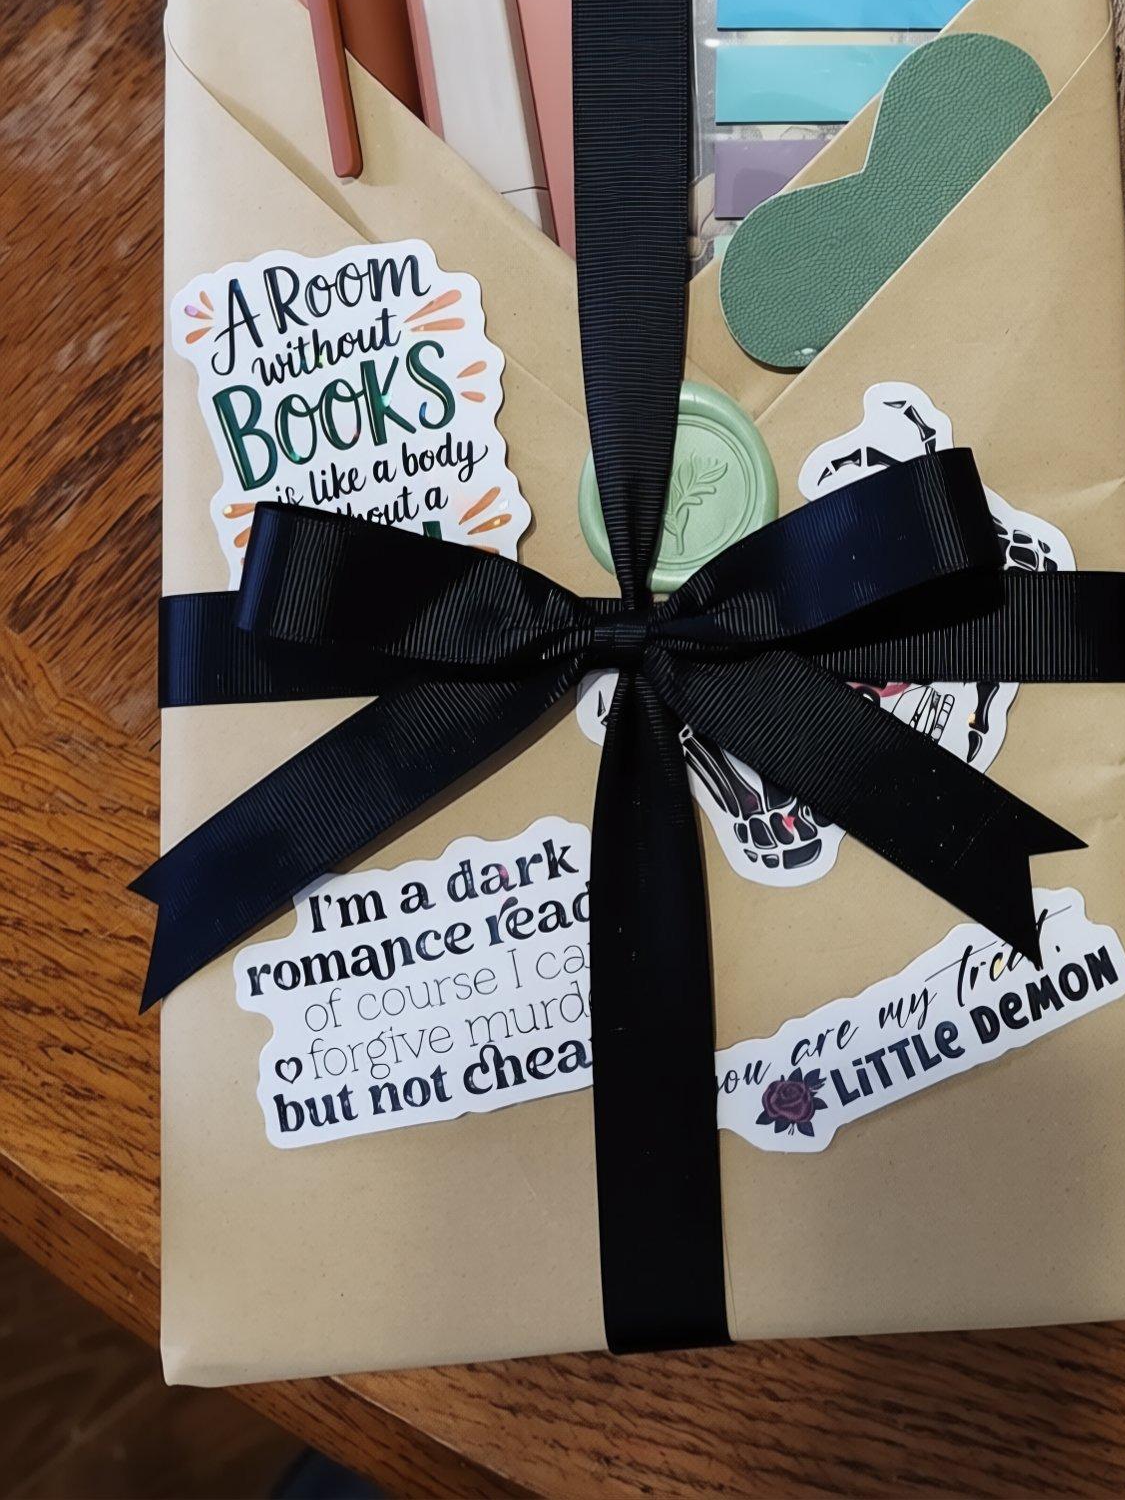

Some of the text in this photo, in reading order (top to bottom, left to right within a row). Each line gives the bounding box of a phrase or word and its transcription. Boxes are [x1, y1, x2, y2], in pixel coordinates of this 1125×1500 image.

[211, 277, 264, 377] A
[251, 307, 402, 387] without
[211, 338, 457, 493] BOOKS
[308, 462, 367, 506] like
[371, 459, 398, 483] a
[401, 431, 490, 483] body
[423, 485, 450, 512] a
[308, 838, 580, 935] I'm a dark
[246, 919, 476, 999] romance
[304, 941, 591, 1034] of course I ca
[306, 981, 592, 1080] forgive murd
[790, 1019, 861, 1067] are
[878, 985, 938, 1030] my
[273, 1038, 592, 1133] but not chea
